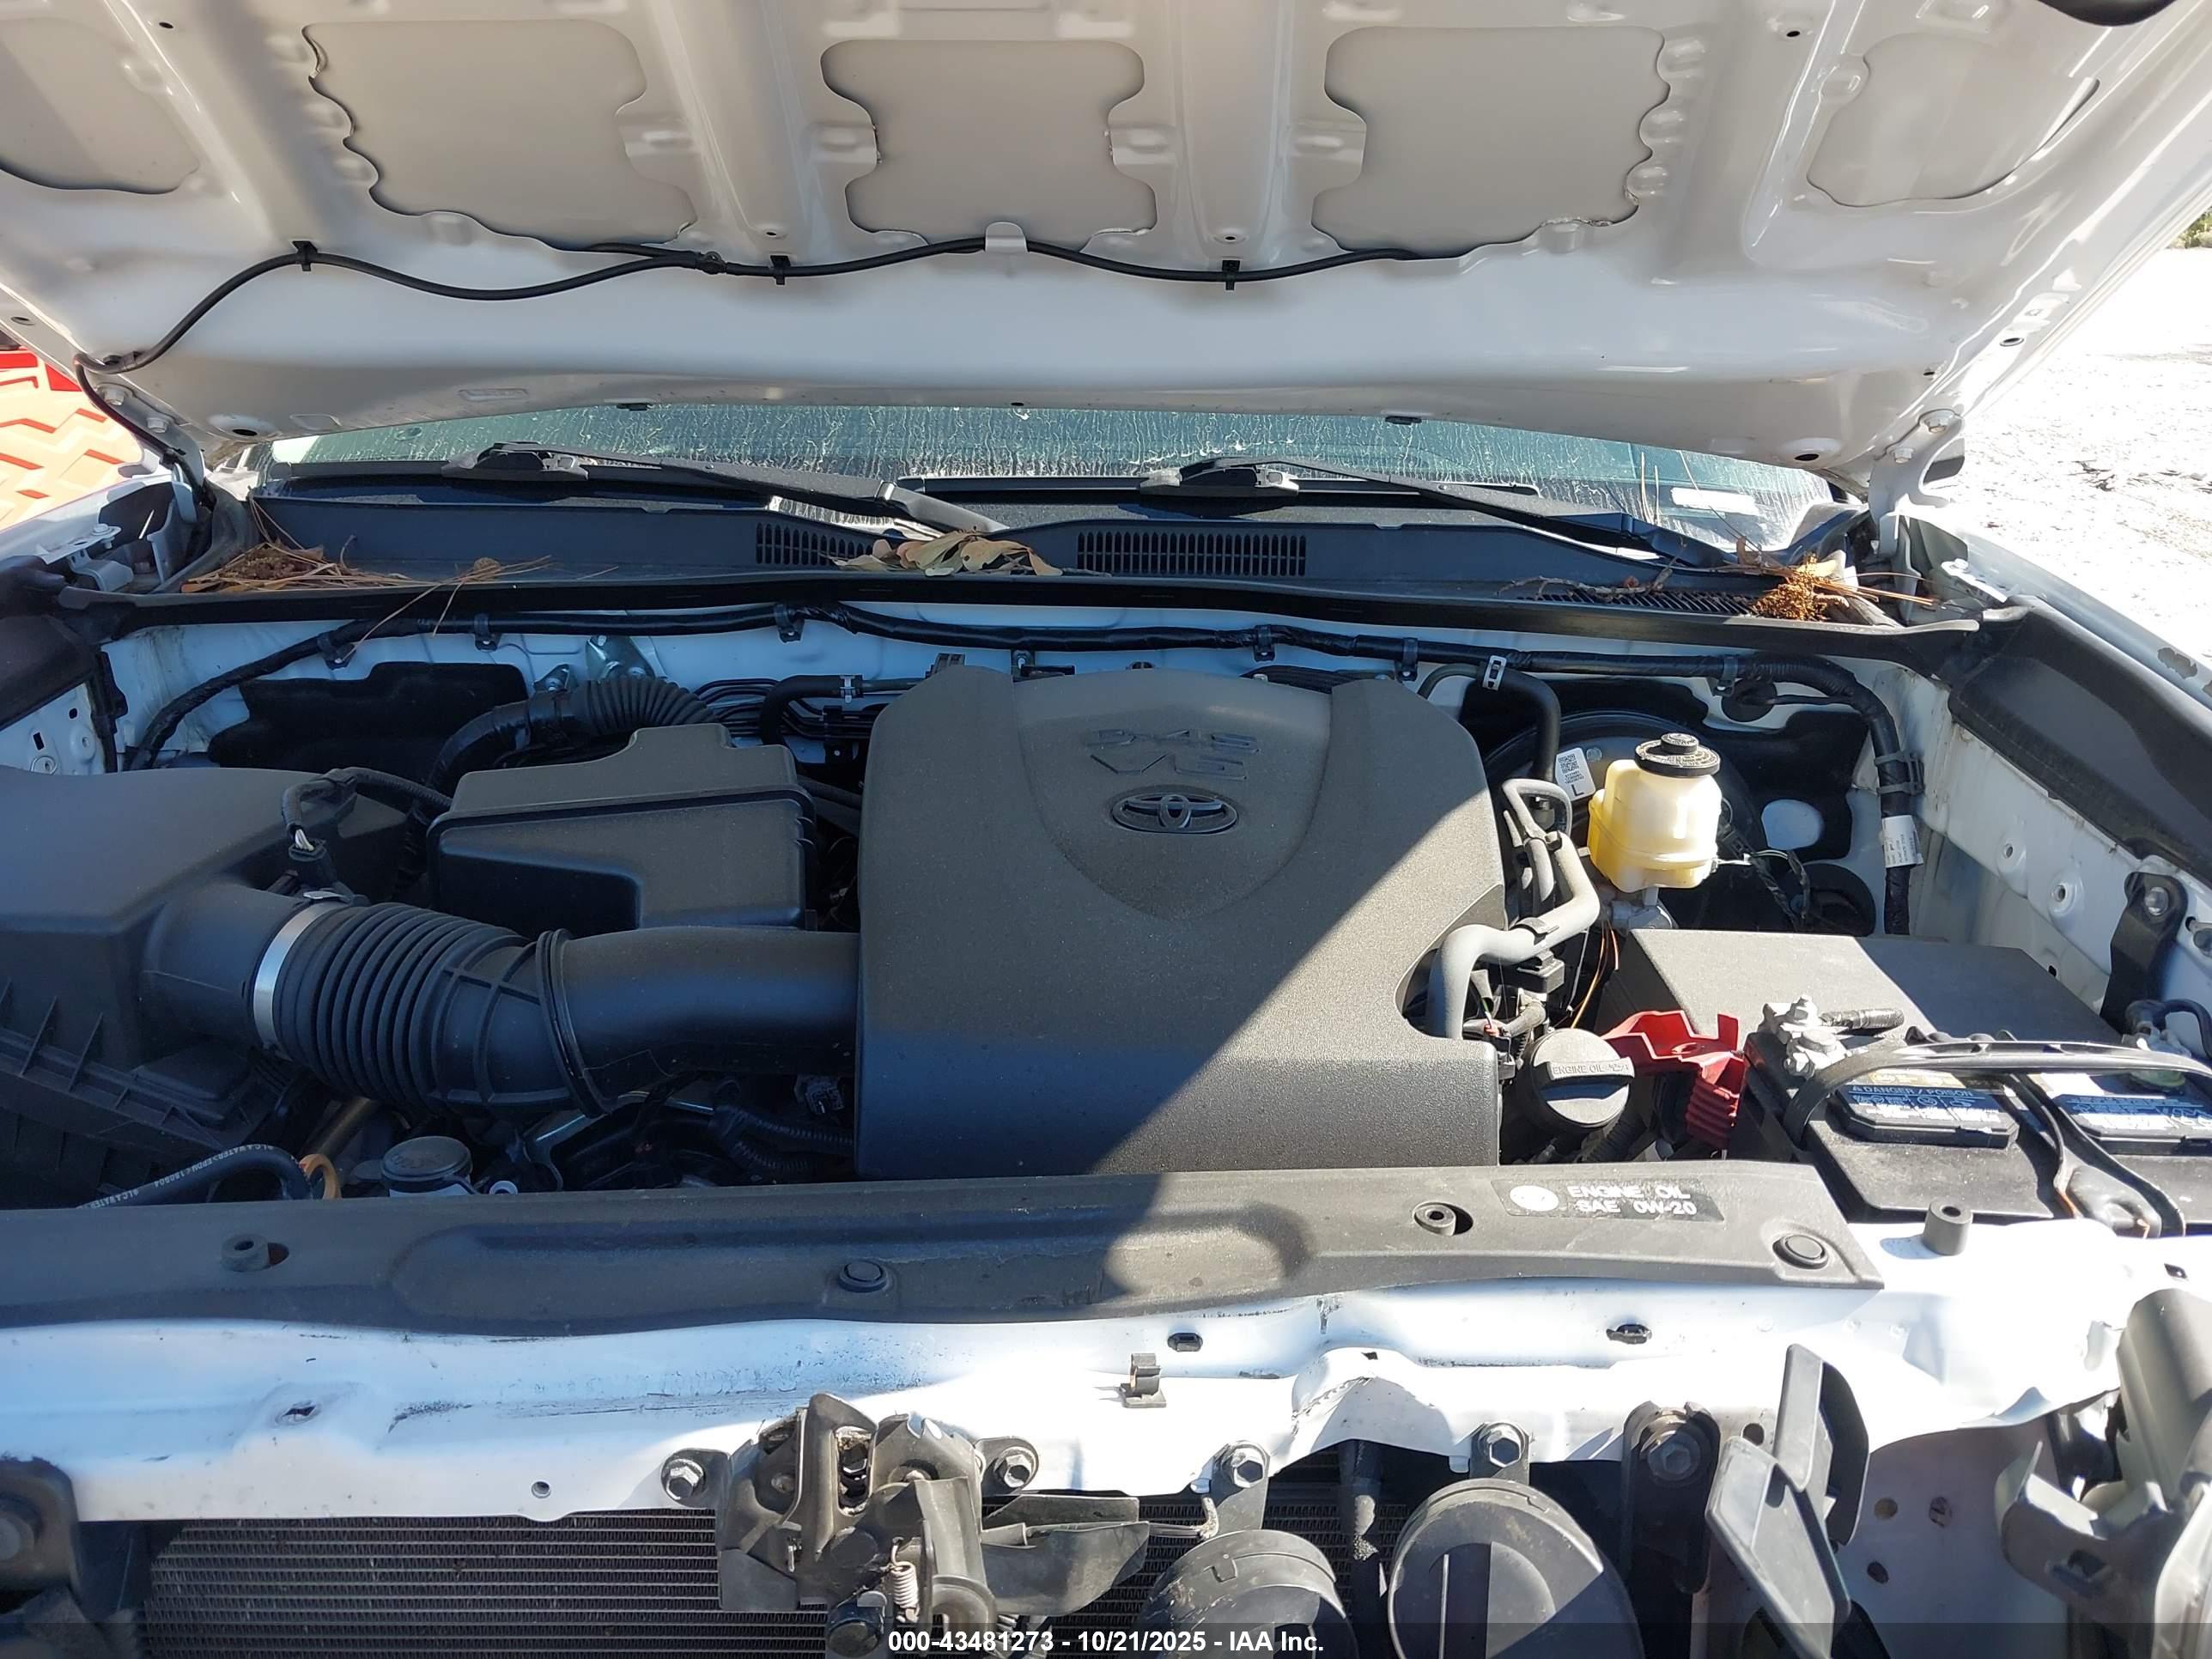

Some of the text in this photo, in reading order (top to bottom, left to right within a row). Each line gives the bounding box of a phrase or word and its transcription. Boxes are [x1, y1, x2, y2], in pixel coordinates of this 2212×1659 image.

[1571, 784, 1585, 797] L
[1552, 1065, 1606, 1075] ENGINE OIL
[1927, 1086, 1974, 1097] POISON
[1566, 1185, 1691, 1199] ENGINE OIL
[1575, 1200, 1698, 1216] SAE 0W-20
